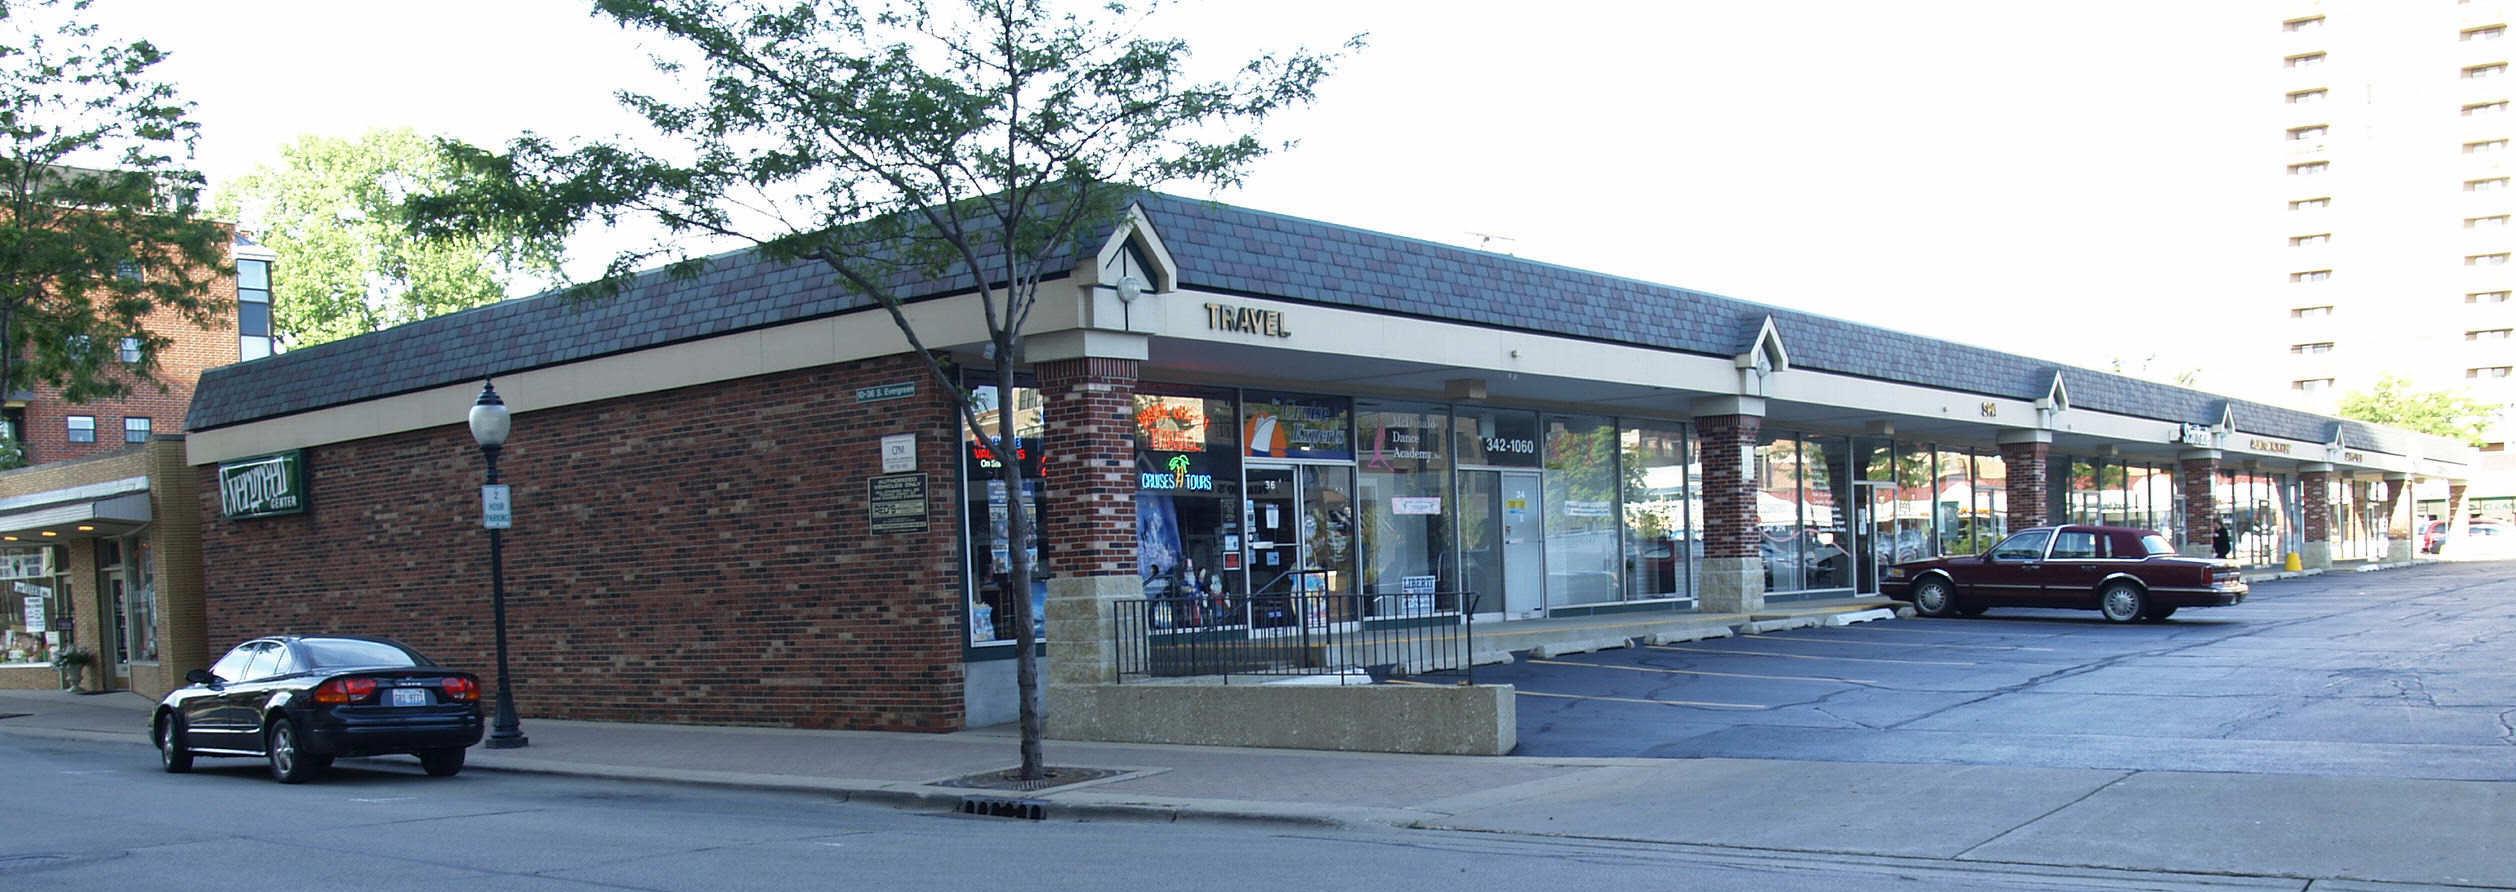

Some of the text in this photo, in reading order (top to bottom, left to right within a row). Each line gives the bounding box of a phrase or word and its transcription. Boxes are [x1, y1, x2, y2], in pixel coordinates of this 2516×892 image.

[1205, 303, 1291, 337] TRAVEL
[1291, 423, 1345, 448] Experts
[1393, 431, 1420, 443] Dance
[1486, 438, 1534, 454] 342-1060
[980, 459, 990, 468] On
[1393, 447, 1432, 464] Academy
[220, 459, 288, 516] Evergreen
[1142, 473, 1175, 489] CRUISES
[1185, 475, 1212, 490] TOURS
[1265, 480, 1276, 490] 36
[271, 495, 297, 509] CENTER
[486, 513, 510, 522] PARKING
